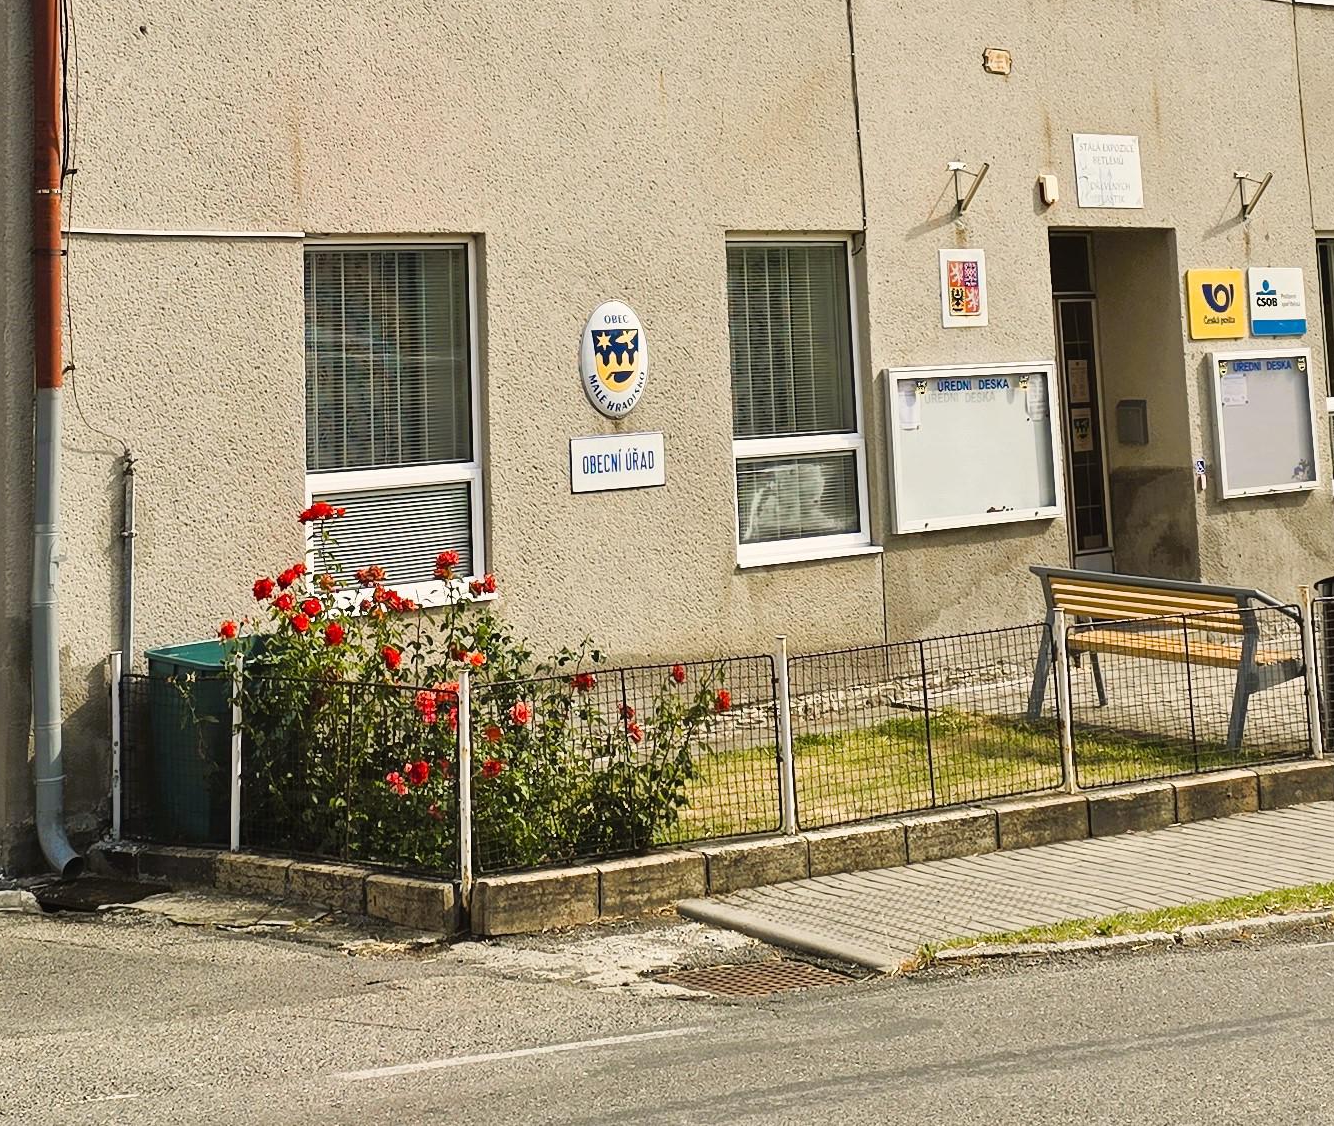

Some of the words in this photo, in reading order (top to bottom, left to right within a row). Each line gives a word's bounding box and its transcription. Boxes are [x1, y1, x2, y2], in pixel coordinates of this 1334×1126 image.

[1256, 296, 1278, 307] ČSOB
[604, 314, 629, 324] OBEC
[1204, 315, 1219, 324] Česká
[1266, 359, 1292, 371] DESKA
[978, 378, 1010, 390] DESKA
[606, 371, 645, 412] HRADISKO
[582, 448, 622, 475] OBECNÍ
[625, 447, 655, 471] ÚŘAD
